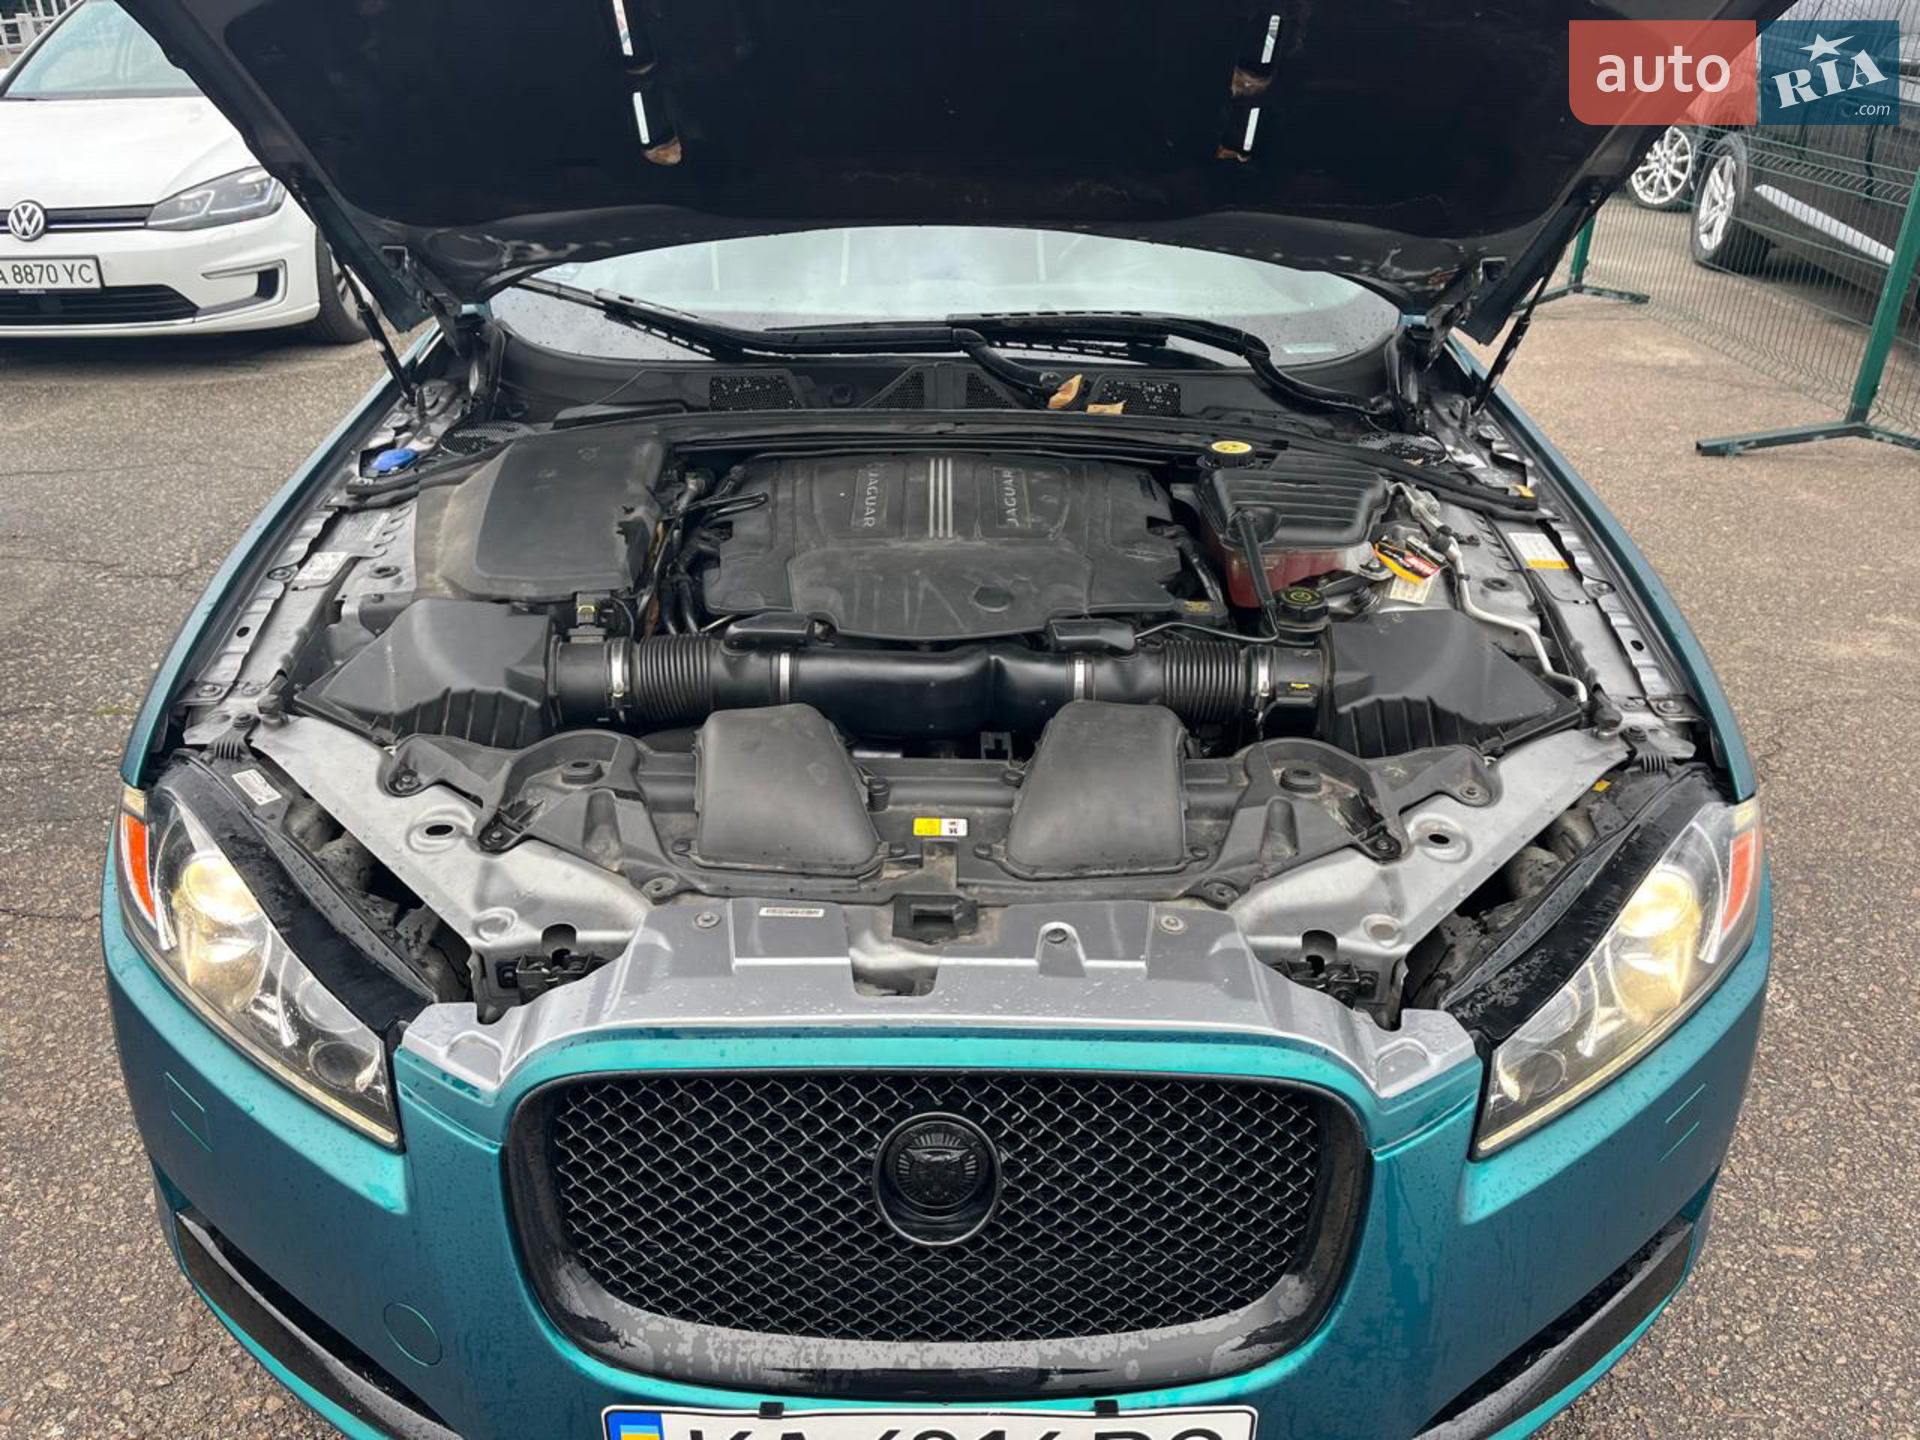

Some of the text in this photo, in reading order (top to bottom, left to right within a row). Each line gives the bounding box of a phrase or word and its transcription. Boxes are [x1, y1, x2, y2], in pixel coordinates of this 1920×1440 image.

[11, 264, 59, 284] 8870
[62, 263, 94, 284] YC
[864, 470, 880, 528] JAGUAR
[1002, 470, 1020, 528] JAGUAR
